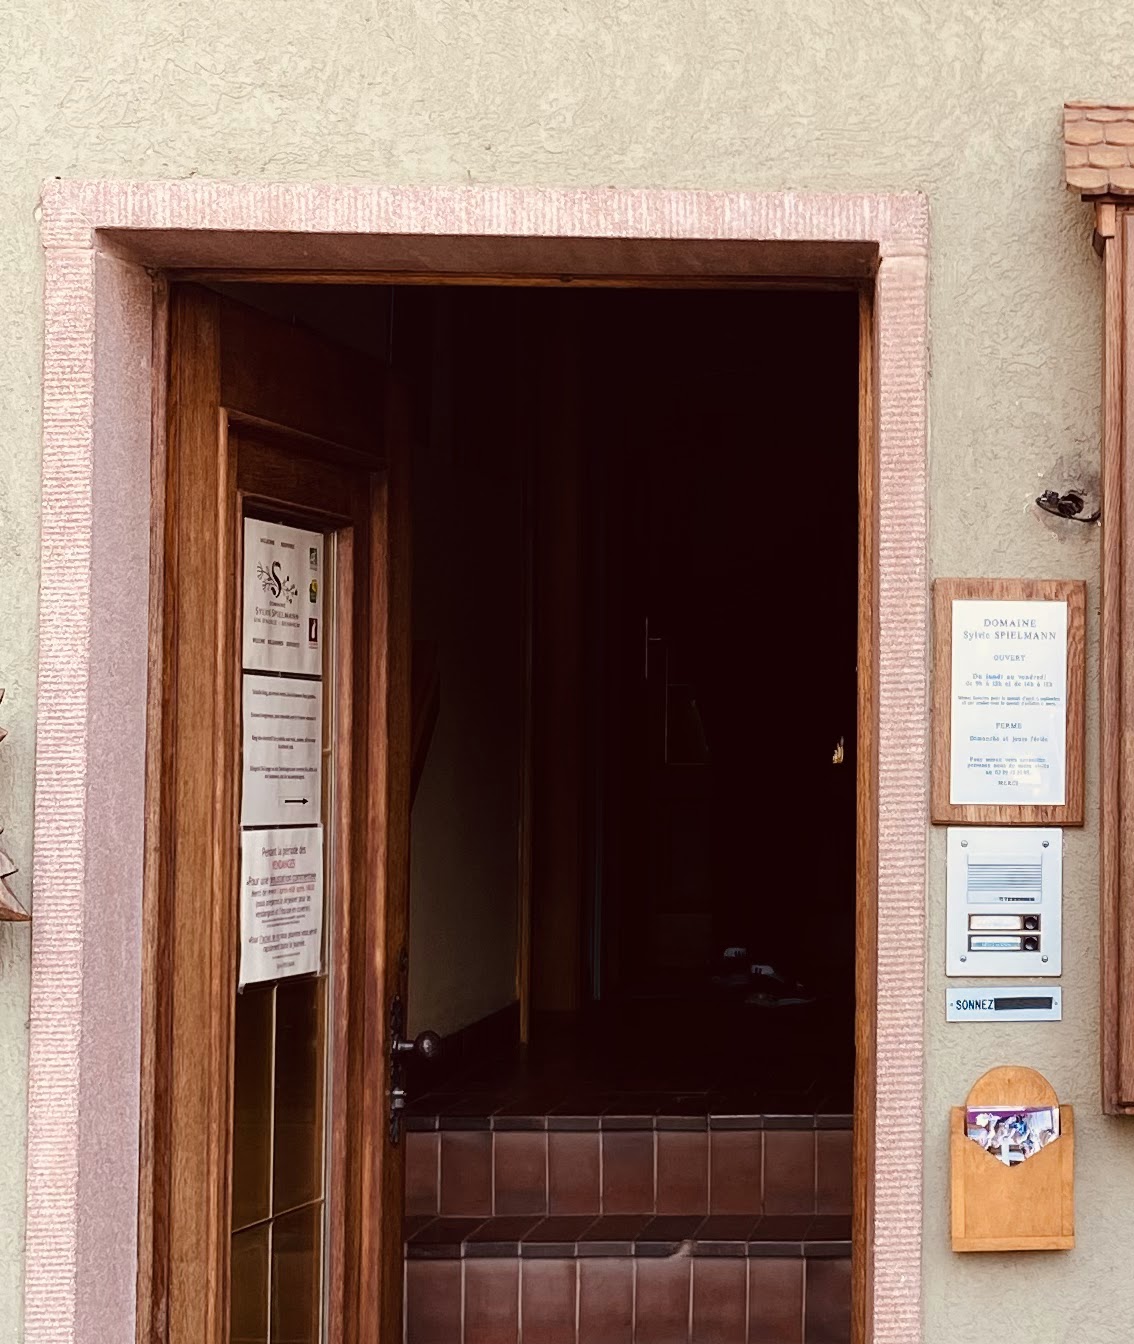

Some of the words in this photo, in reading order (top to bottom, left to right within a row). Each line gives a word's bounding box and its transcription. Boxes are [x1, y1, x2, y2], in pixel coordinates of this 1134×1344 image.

[984, 618, 1036, 627] DOMAINE
[963, 630, 990, 641] Sylvie
[994, 631, 1056, 640] SPIELMANN
[956, 999, 994, 1010] SONNEZ
